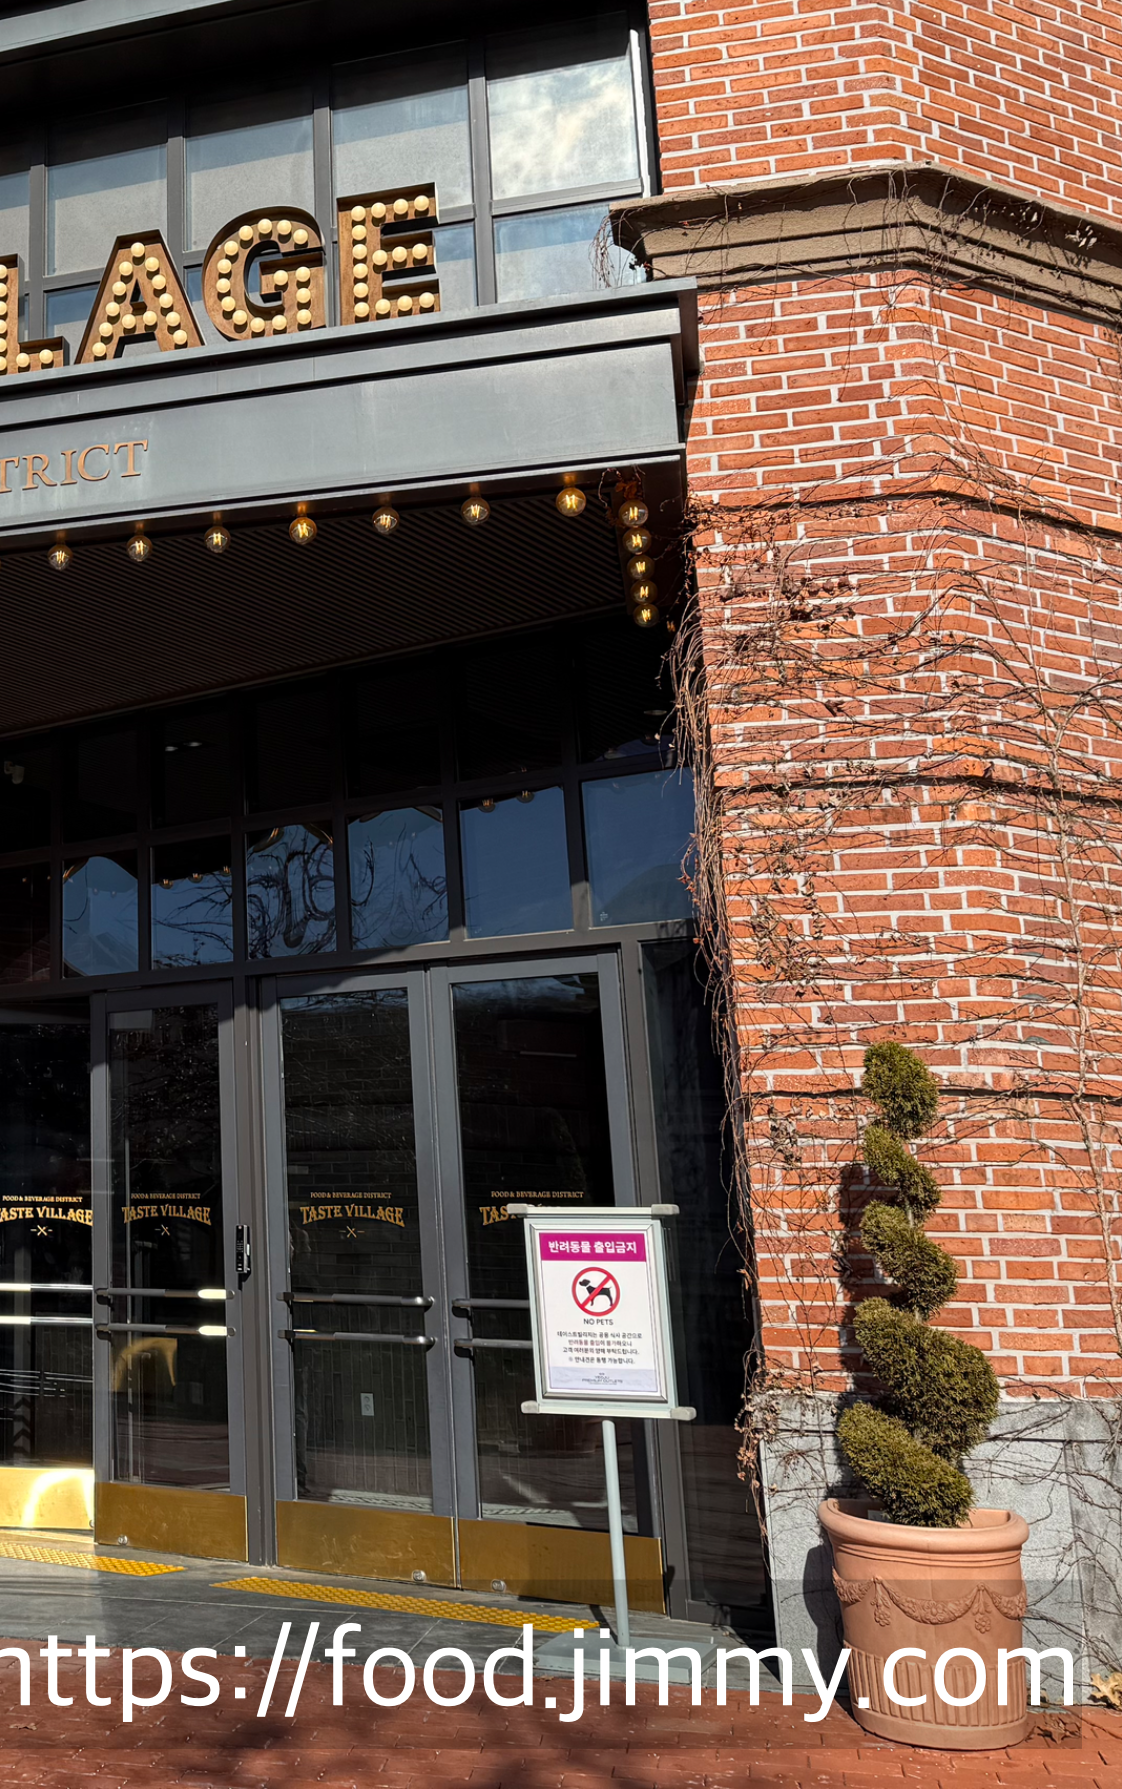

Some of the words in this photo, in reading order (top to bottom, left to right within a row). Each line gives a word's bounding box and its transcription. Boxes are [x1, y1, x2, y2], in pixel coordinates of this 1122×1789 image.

[36, 1206, 94, 1226] VILLAGE
[122, 1205, 158, 1224] TASTE
[160, 1204, 211, 1225] VILLAGE
[300, 1206, 343, 1224] TASTE
[344, 1204, 405, 1227] VILLAGE
[549, 1241, 591, 1253] 반려동물
[594, 1241, 637, 1254] 출입금지
